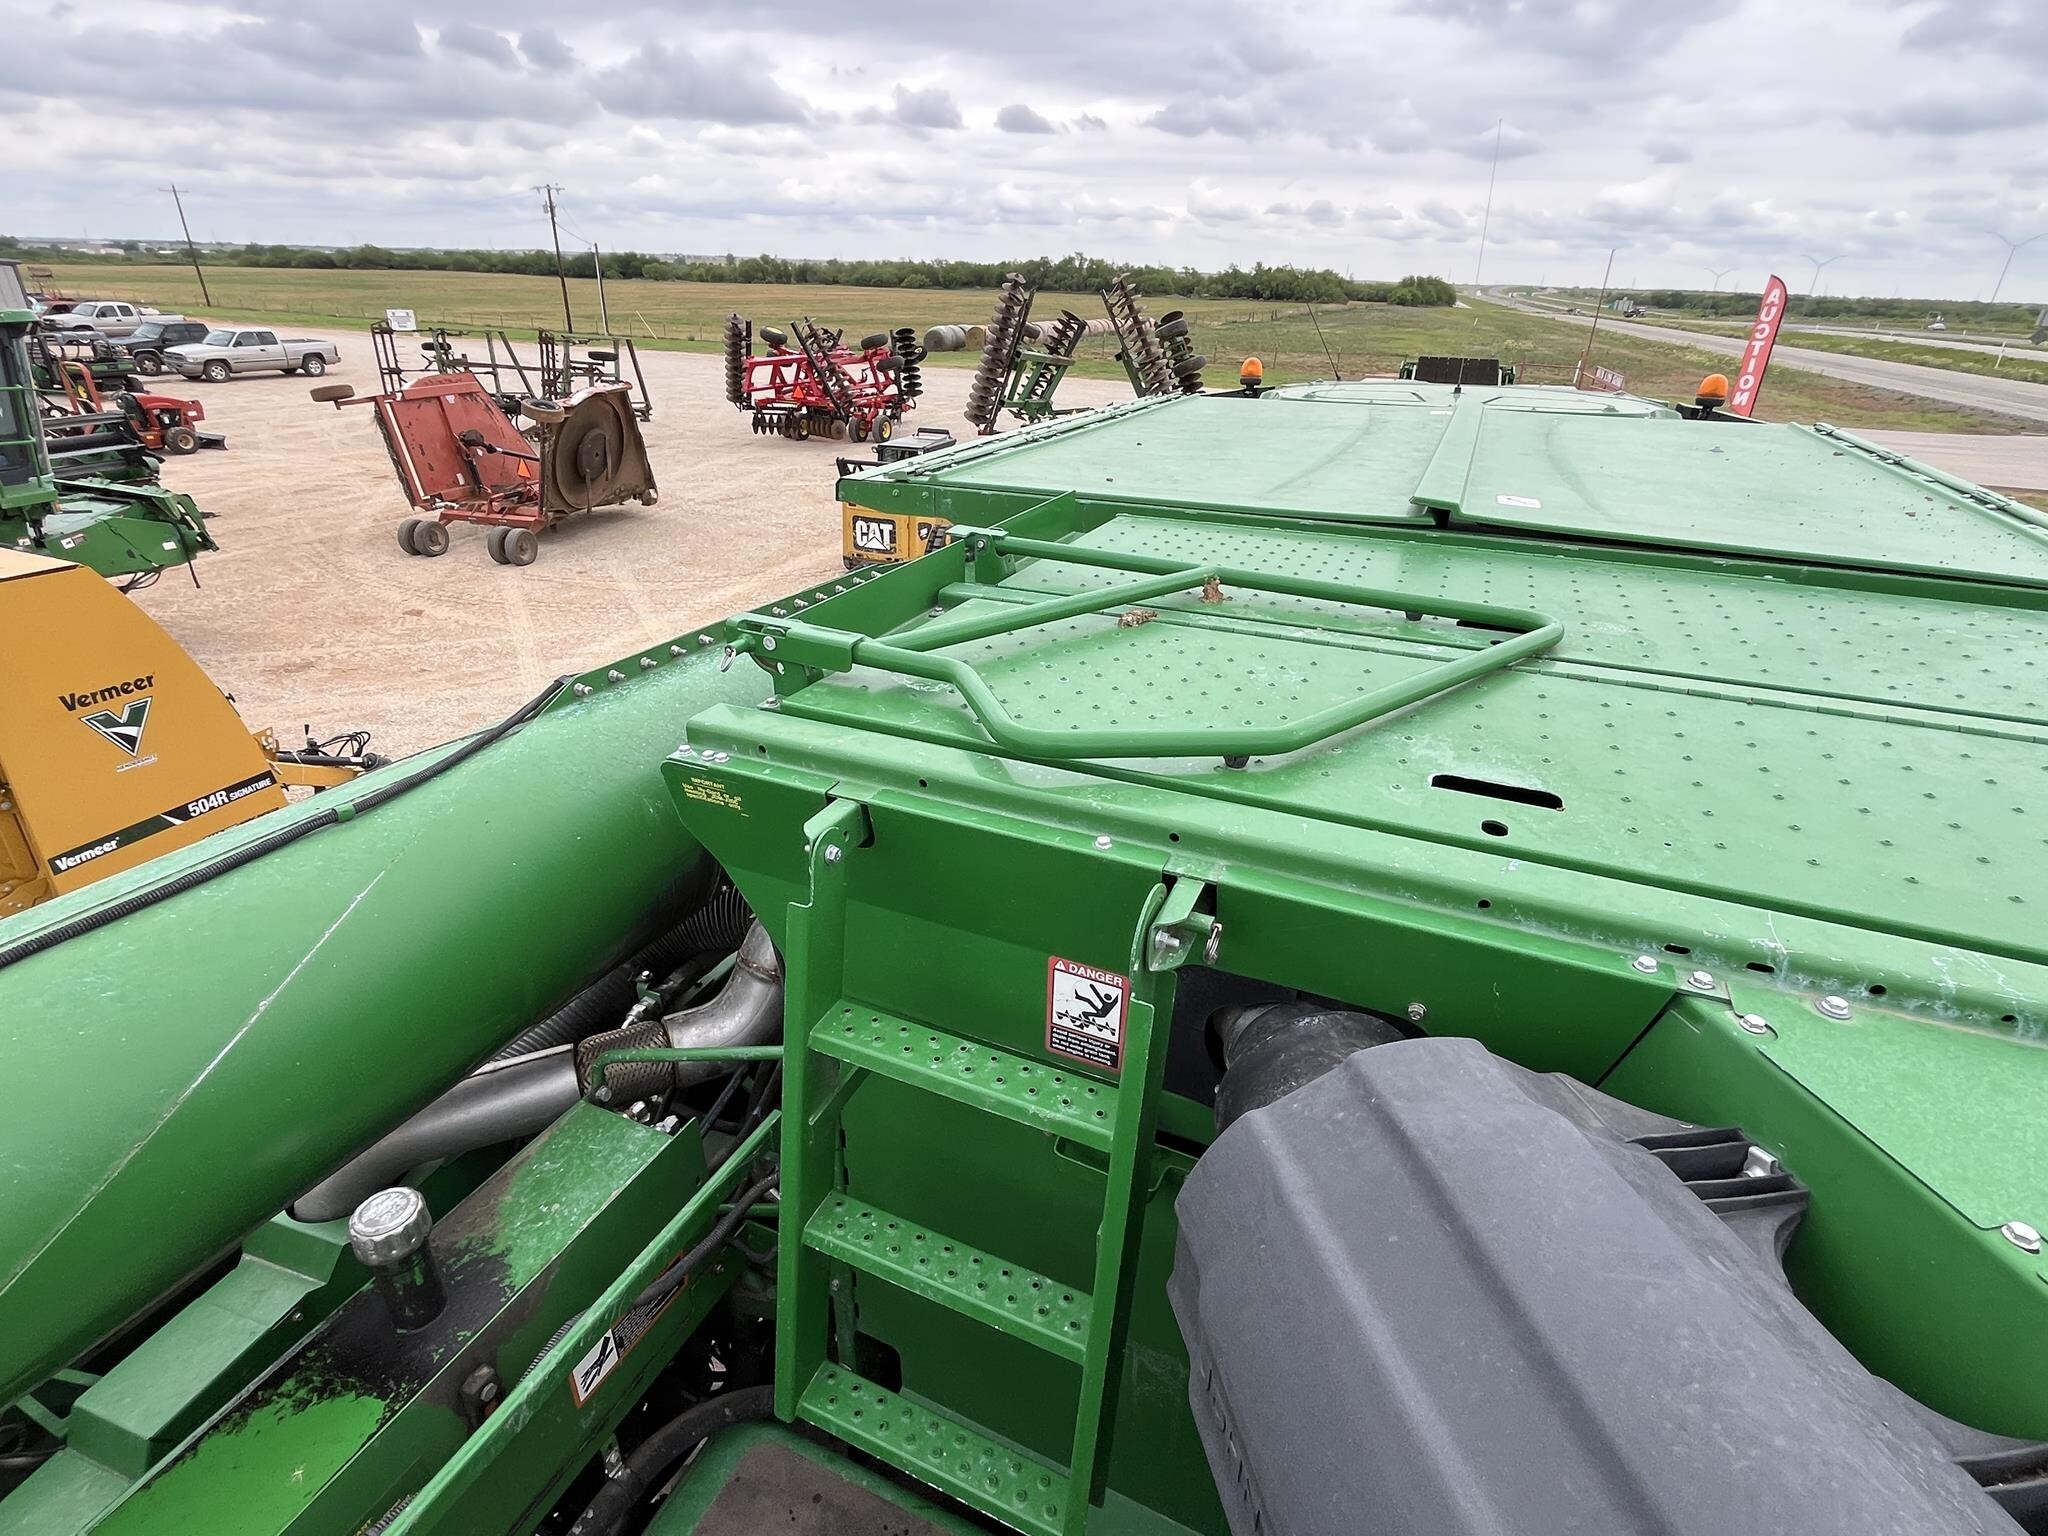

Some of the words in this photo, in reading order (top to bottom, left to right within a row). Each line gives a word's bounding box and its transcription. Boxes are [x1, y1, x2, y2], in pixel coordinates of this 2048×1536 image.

[855, 520, 893, 550] CAT
[58, 674, 154, 712] Vermeer
[187, 790, 229, 817] 504R
[229, 777, 272, 801] SIGNATURE
[55, 837, 119, 871] Vermeer
[1068, 963, 1123, 987] DANGER
